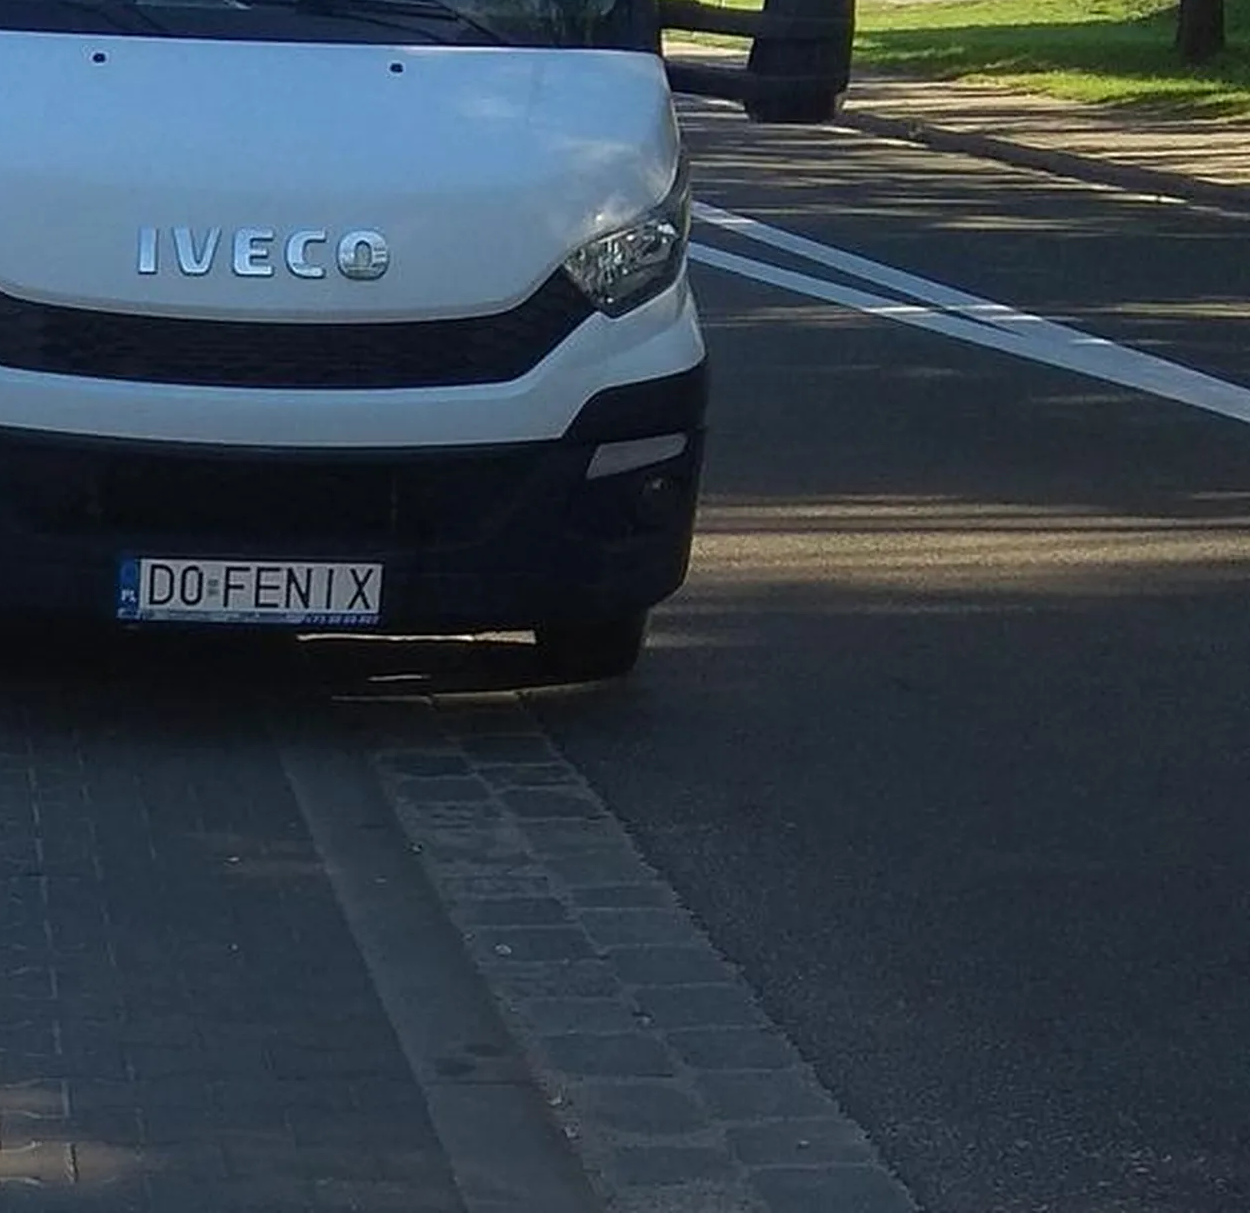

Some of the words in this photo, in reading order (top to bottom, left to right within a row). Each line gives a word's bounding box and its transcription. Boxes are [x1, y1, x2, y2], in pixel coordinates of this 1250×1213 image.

[137, 226, 390, 280] IVECO
[149, 564, 203, 606] DO
[223, 566, 374, 610] FENIX
